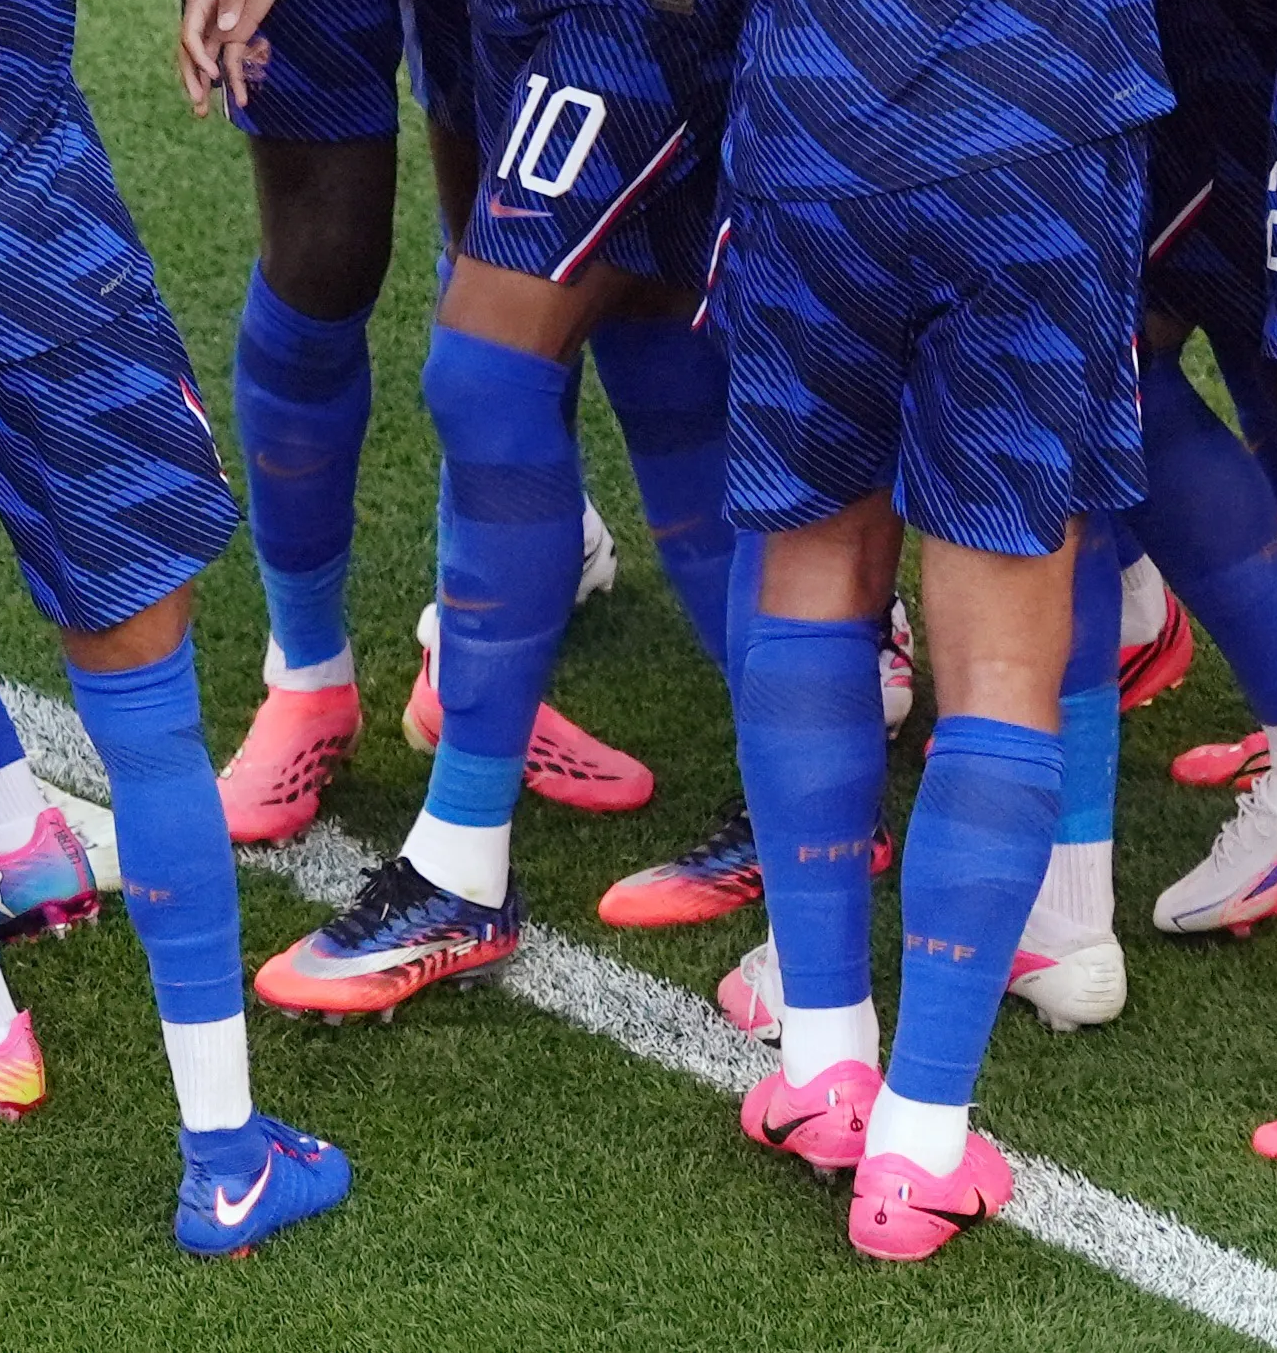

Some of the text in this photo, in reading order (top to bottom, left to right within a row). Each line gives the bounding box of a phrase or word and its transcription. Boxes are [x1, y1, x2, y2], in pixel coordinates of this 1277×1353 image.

[497, 73, 607, 198] 10
[798, 840, 867, 863] FFF
[906, 933, 978, 963] FFF
